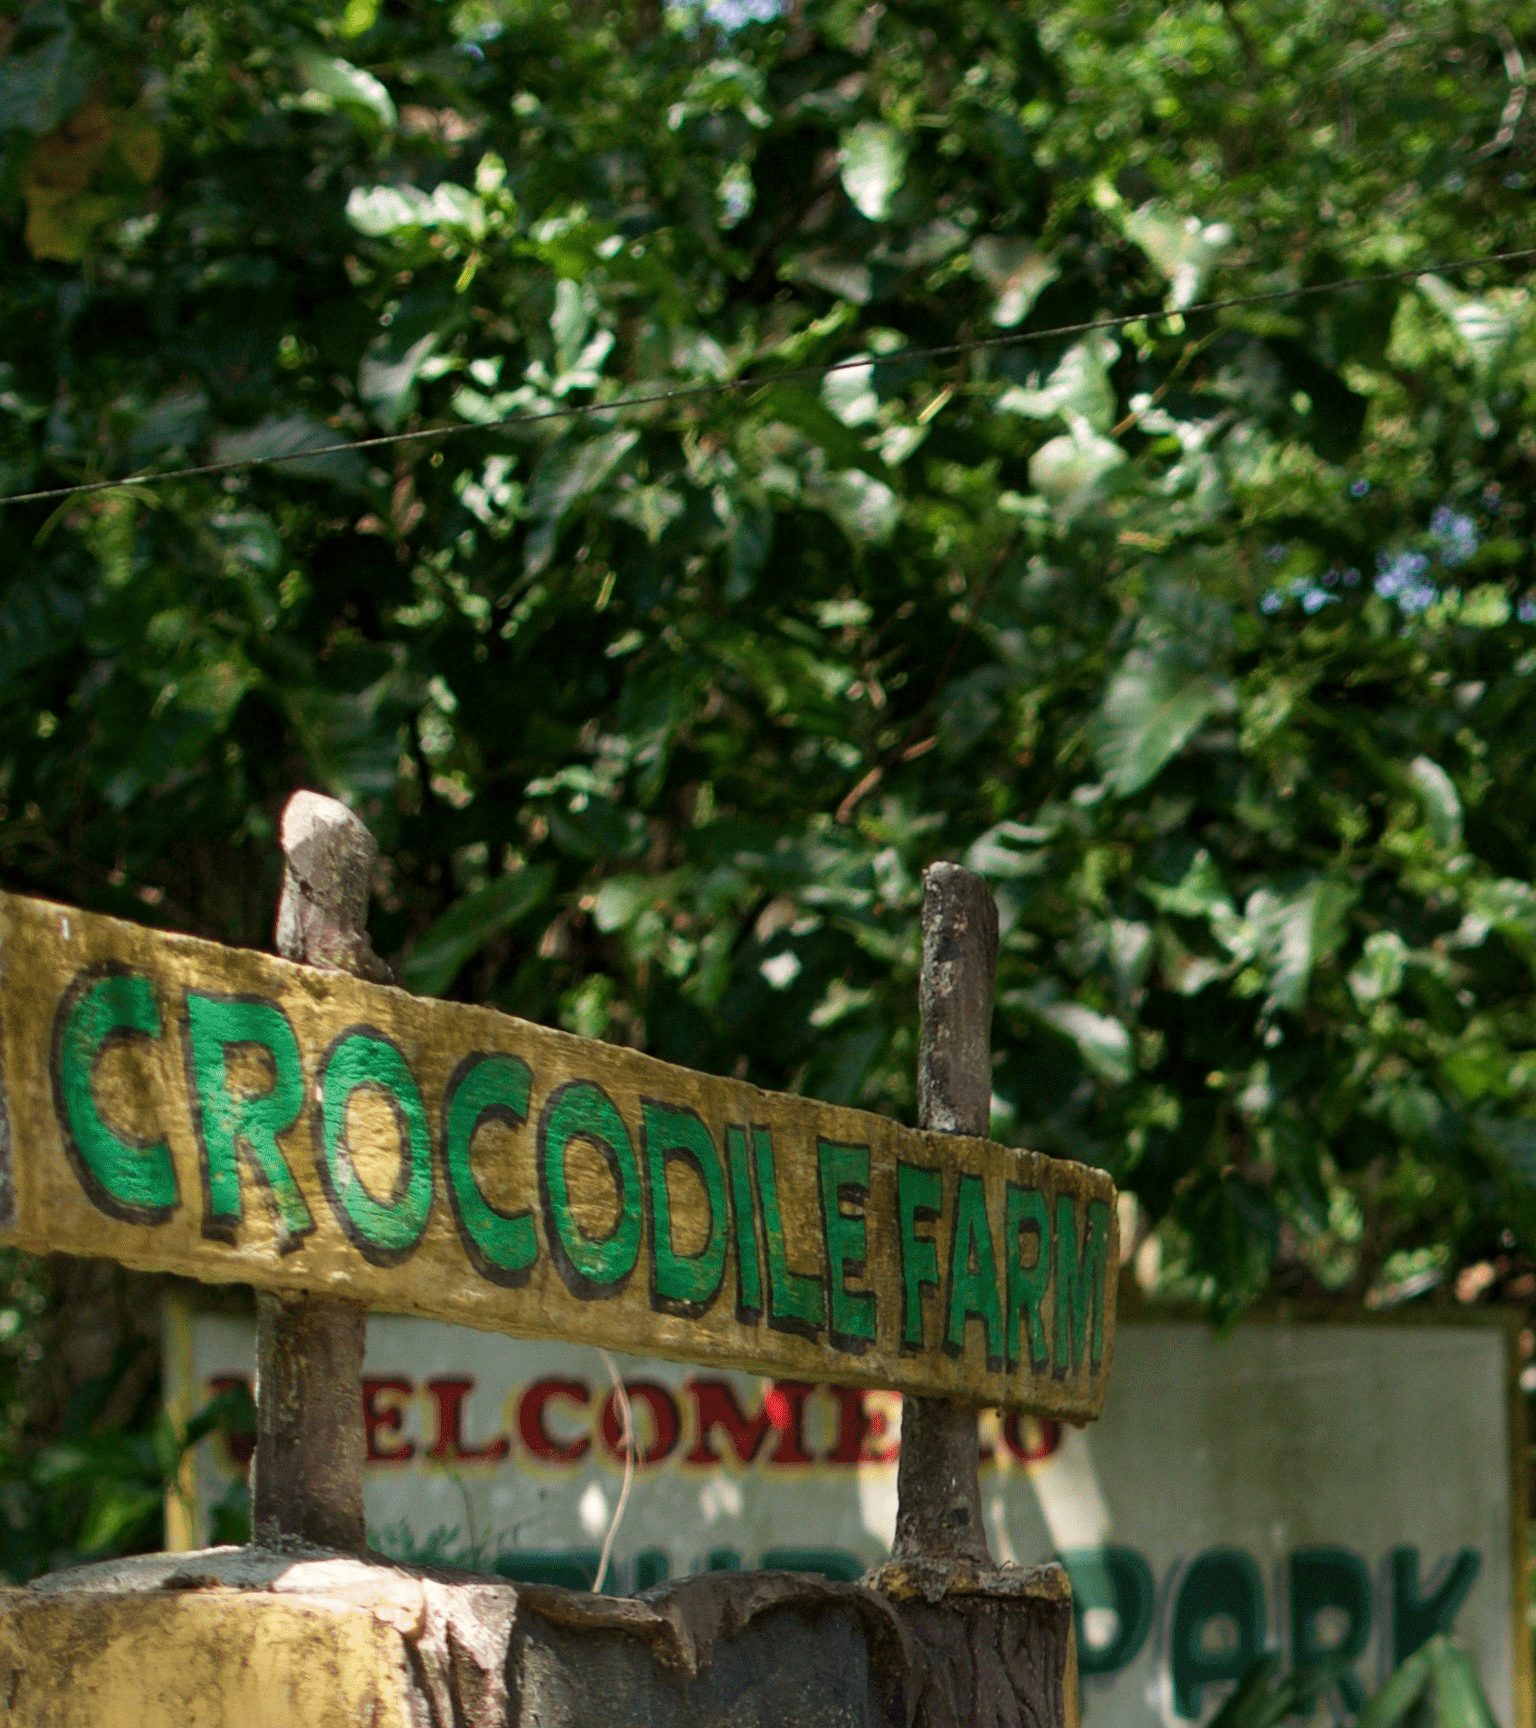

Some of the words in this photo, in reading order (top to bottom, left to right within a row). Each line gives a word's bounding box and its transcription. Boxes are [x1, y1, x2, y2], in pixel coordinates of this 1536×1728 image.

[52, 961, 878, 1355] CROCODILE
[896, 1159, 1110, 1379] FARM
[209, 1372, 902, 1465] ELCOME
[1064, 1545, 1483, 1721] PARK
